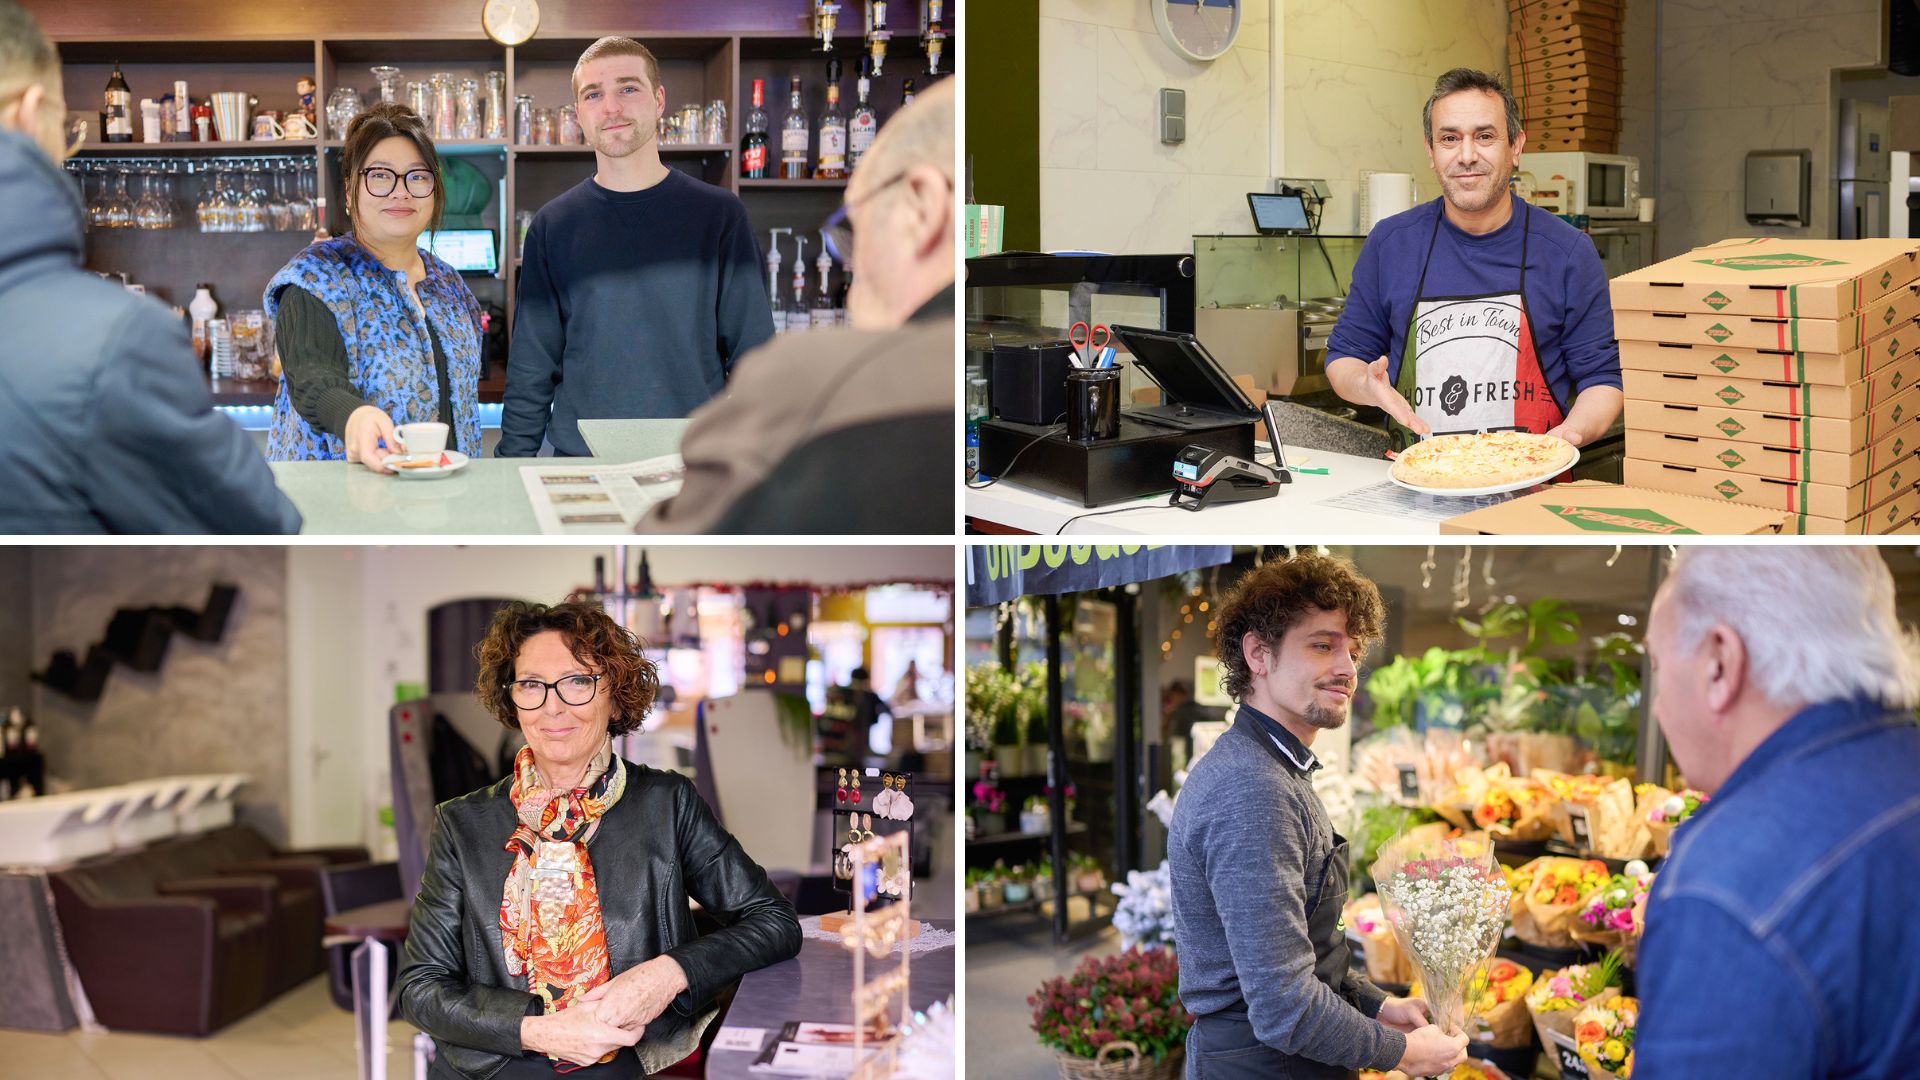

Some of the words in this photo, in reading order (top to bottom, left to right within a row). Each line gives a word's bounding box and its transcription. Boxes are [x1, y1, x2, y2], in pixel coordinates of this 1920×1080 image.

[1416, 314, 1454, 345] Best
[1460, 312, 1479, 327] in
[1483, 307, 1521, 338] Town
[1404, 386, 1436, 408] HOT
[1474, 381, 1534, 403] FRESH
